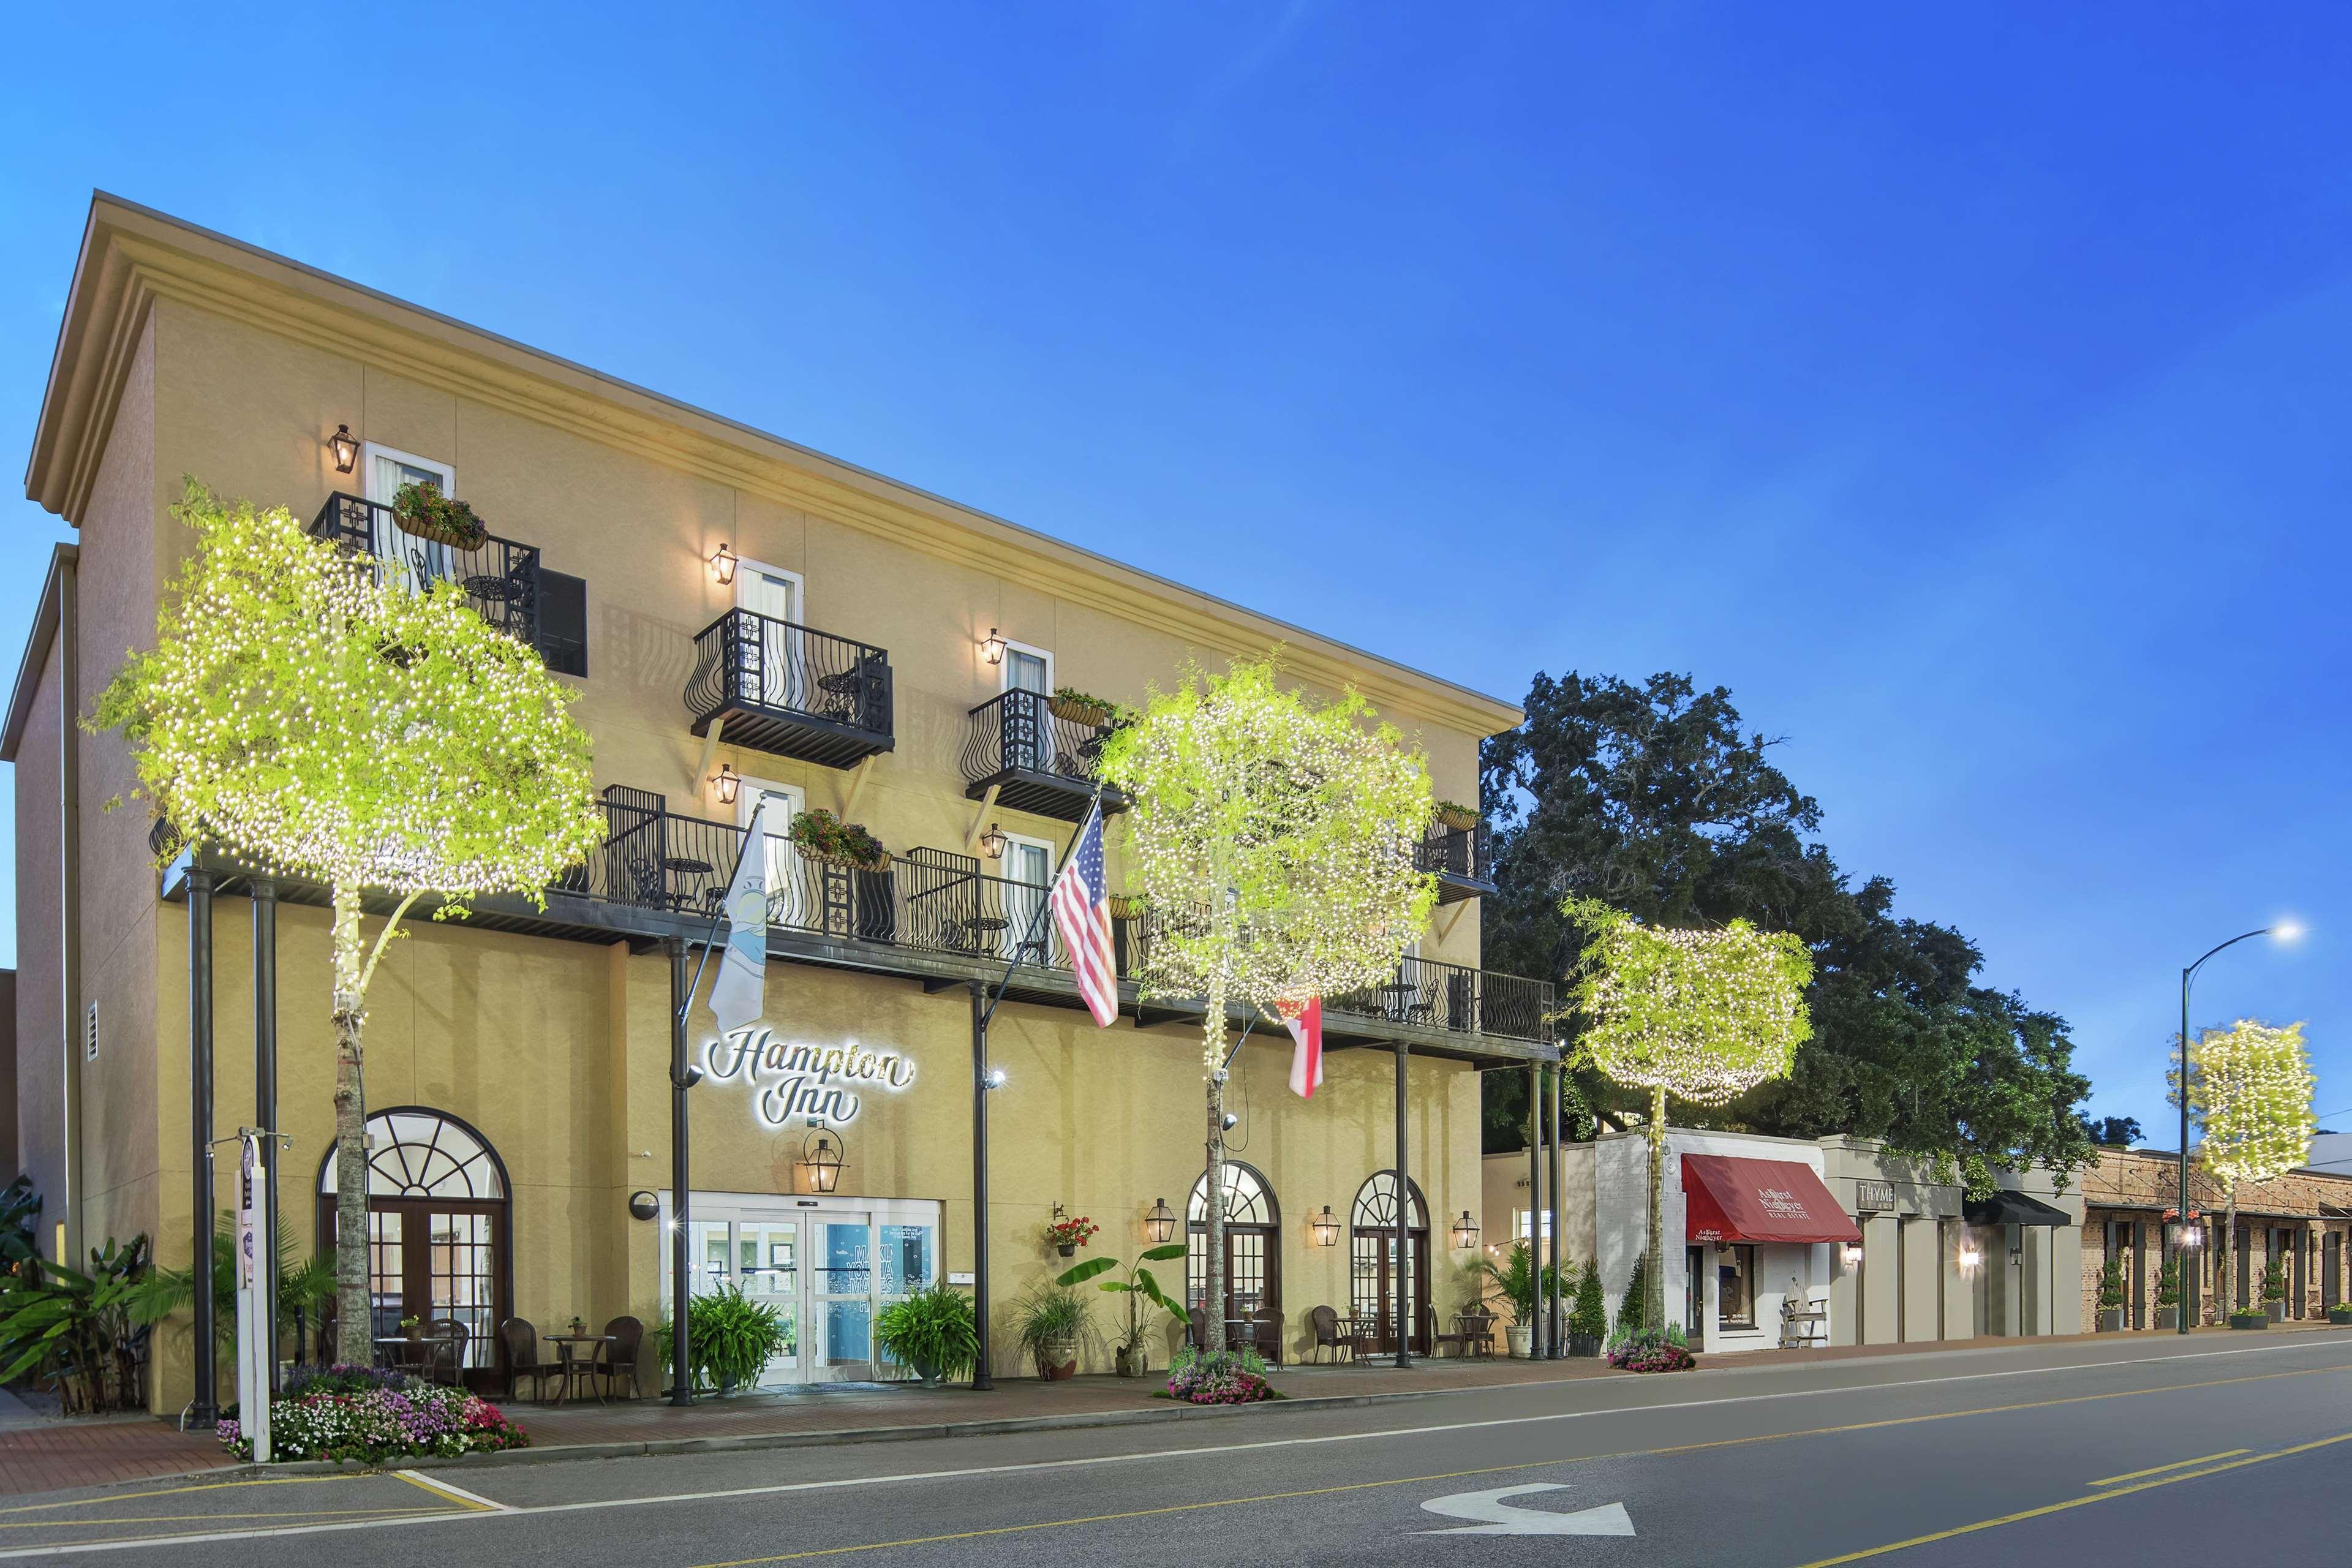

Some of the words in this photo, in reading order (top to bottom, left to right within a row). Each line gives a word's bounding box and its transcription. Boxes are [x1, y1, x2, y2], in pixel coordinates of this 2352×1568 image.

[707, 1029, 914, 1087] Hampton
[762, 1076, 858, 1123] Inn
[1859, 1185, 1893, 1202] THYME
